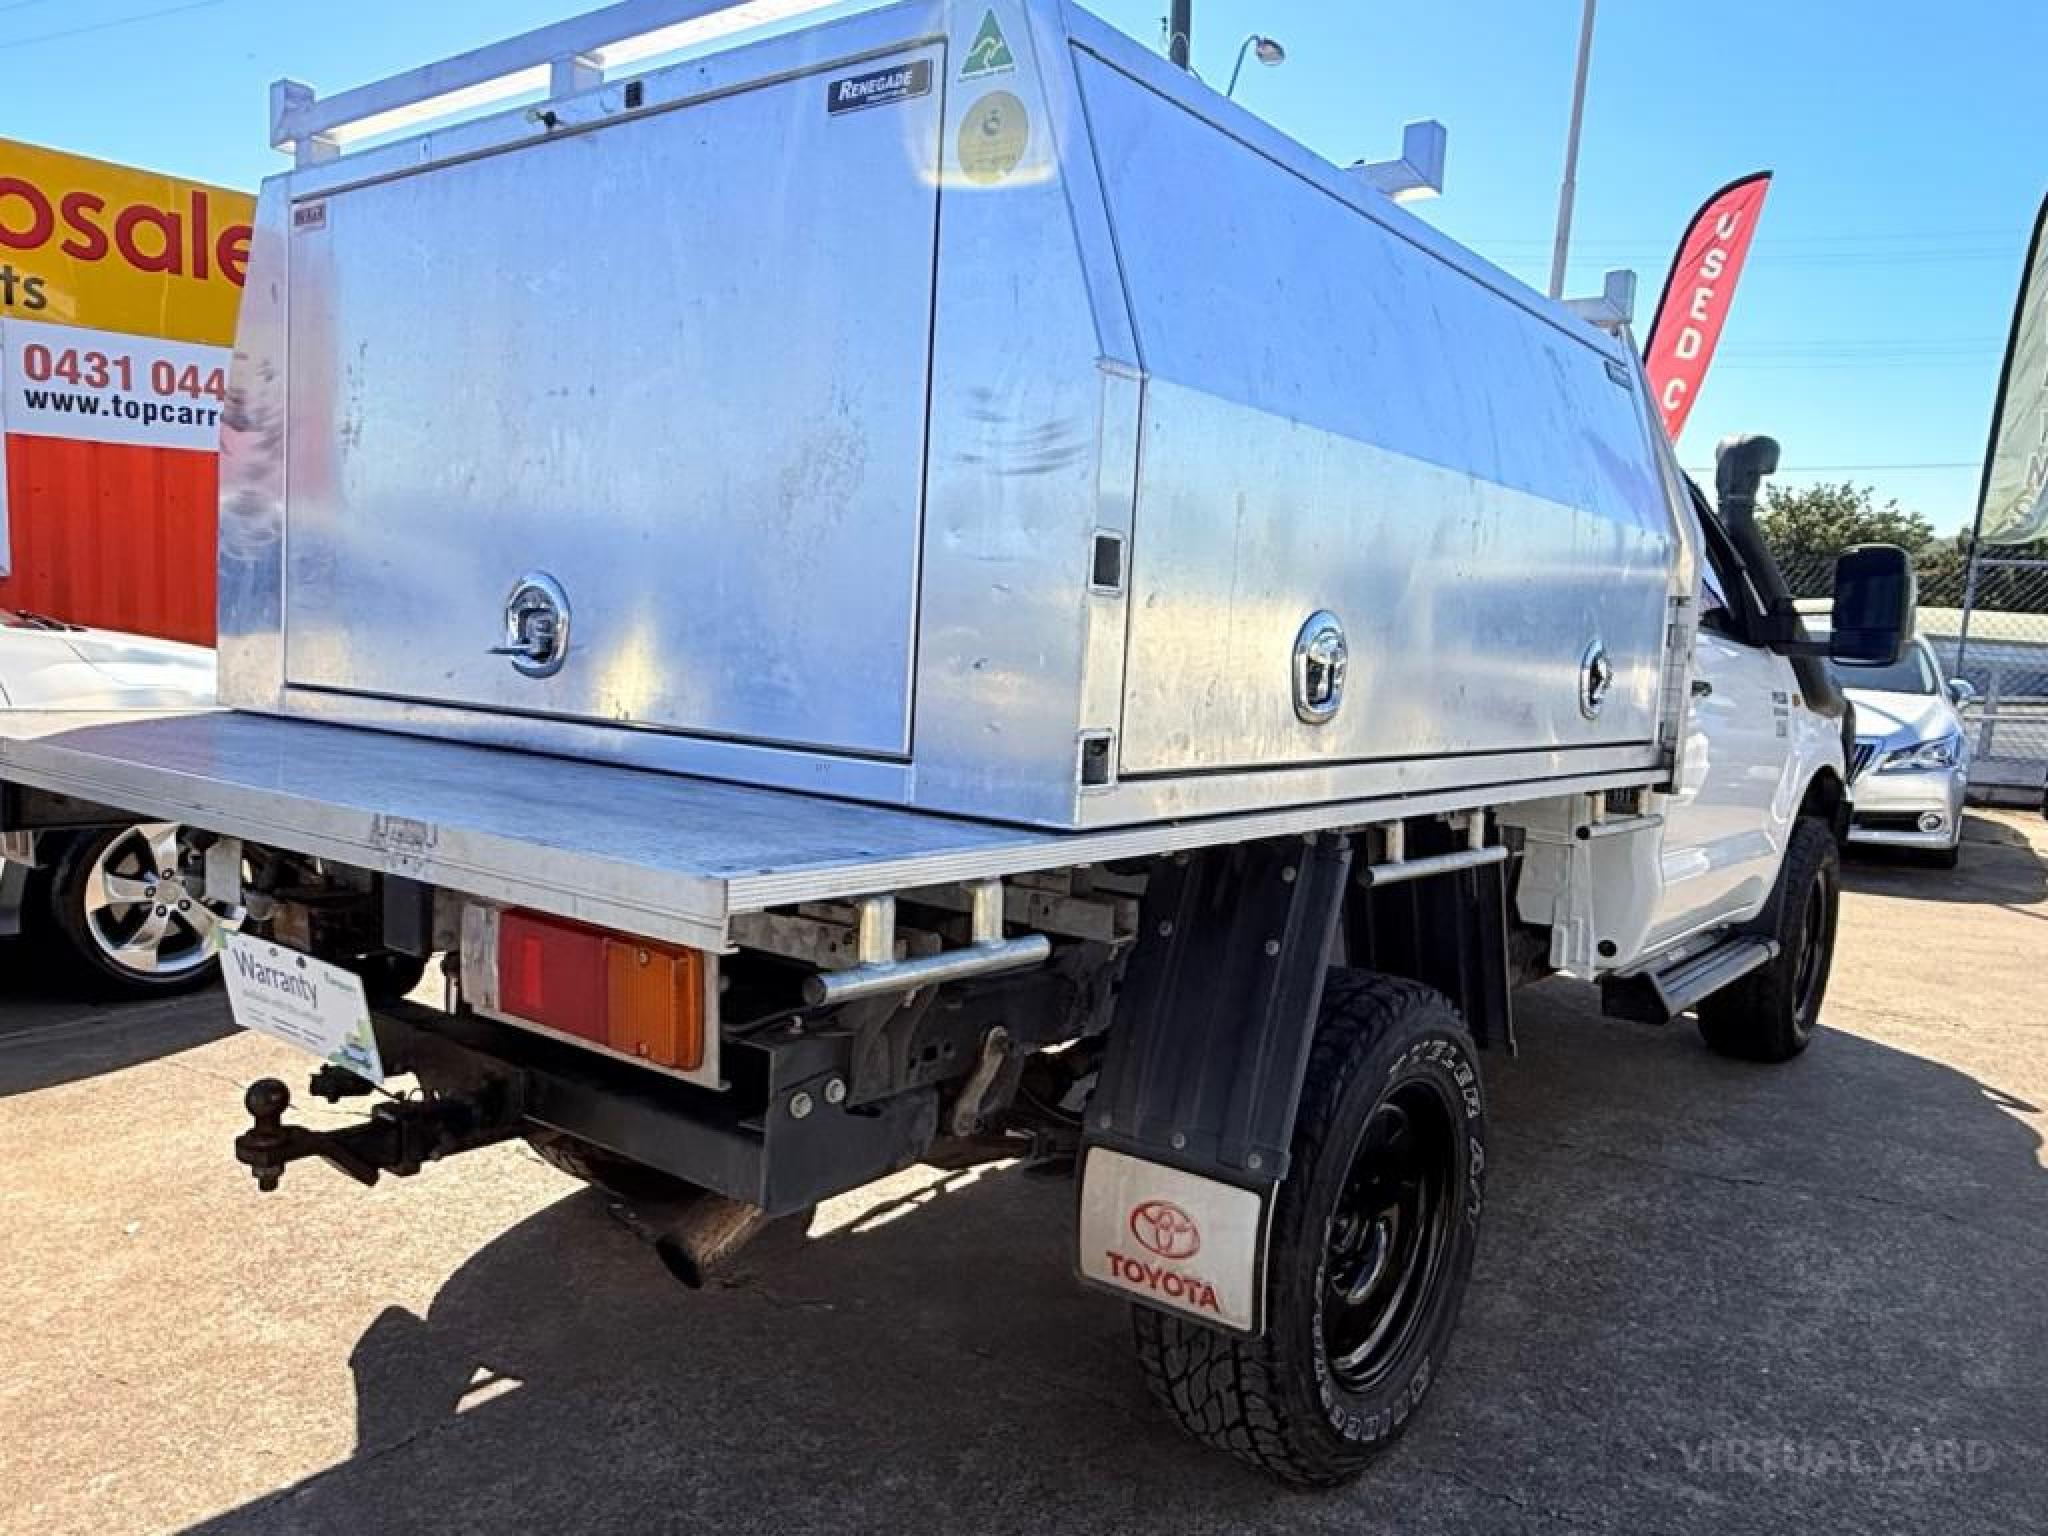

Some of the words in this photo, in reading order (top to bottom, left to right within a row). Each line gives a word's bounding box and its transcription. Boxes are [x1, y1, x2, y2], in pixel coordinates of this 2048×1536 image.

[838, 70, 914, 101] RENEGADE
[1673, 212, 1743, 360] USED
[22, 343, 132, 392] 0431
[151, 360, 225, 403] 044
[23, 388, 223, 427] www.topcarr
[232, 946, 318, 1009] Warranty
[1105, 1250, 1224, 1314] TOYOTA
